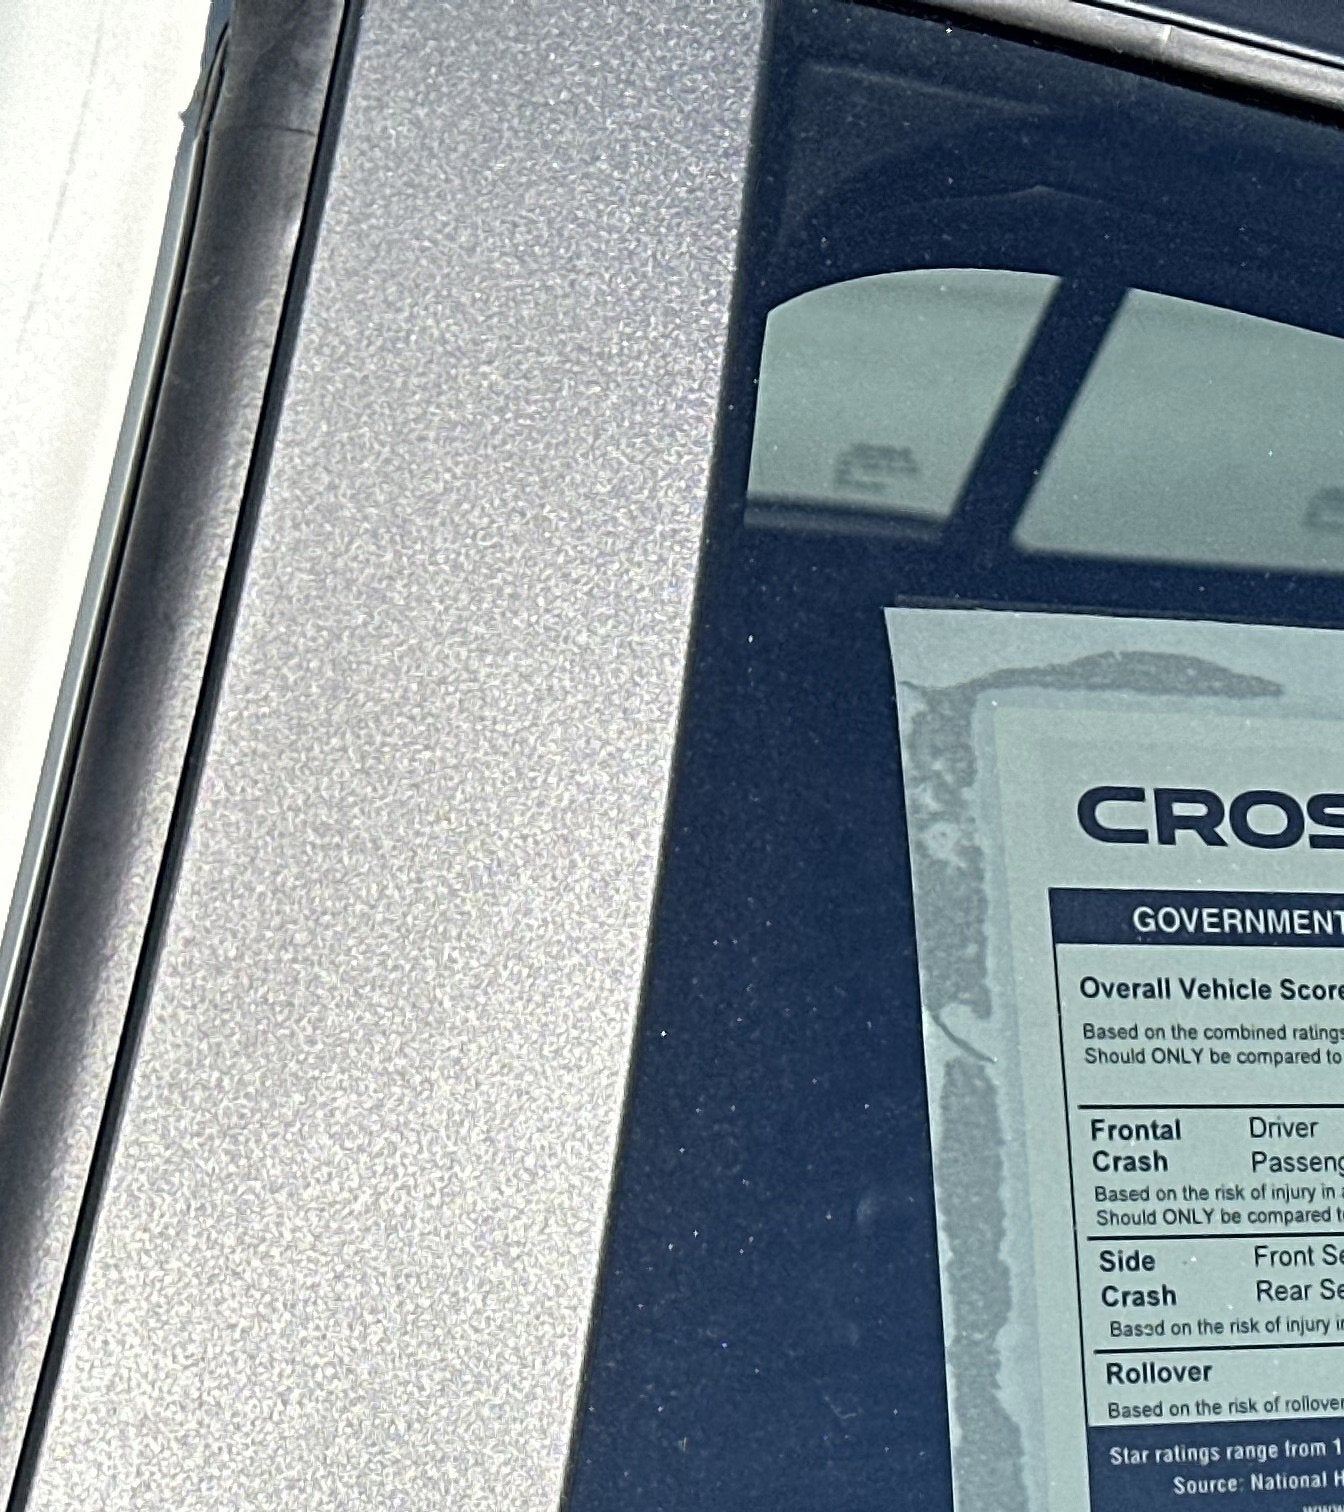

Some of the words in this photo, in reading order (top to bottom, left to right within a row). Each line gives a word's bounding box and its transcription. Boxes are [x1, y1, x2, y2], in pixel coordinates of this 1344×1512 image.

[1079, 975, 1171, 1000] Overall
[1178, 977, 1273, 1001] Vehicle
[1090, 1118, 1182, 1142] Frontal
[1248, 1116, 1320, 1139] Driver
[1092, 1149, 1169, 1173] Crash
[1099, 1249, 1156, 1273] Side
[1254, 1244, 1316, 1268] Front
[1101, 1283, 1177, 1308] Crash
[1256, 1279, 1313, 1303] Rear
[1106, 1361, 1213, 1386] Rollover
